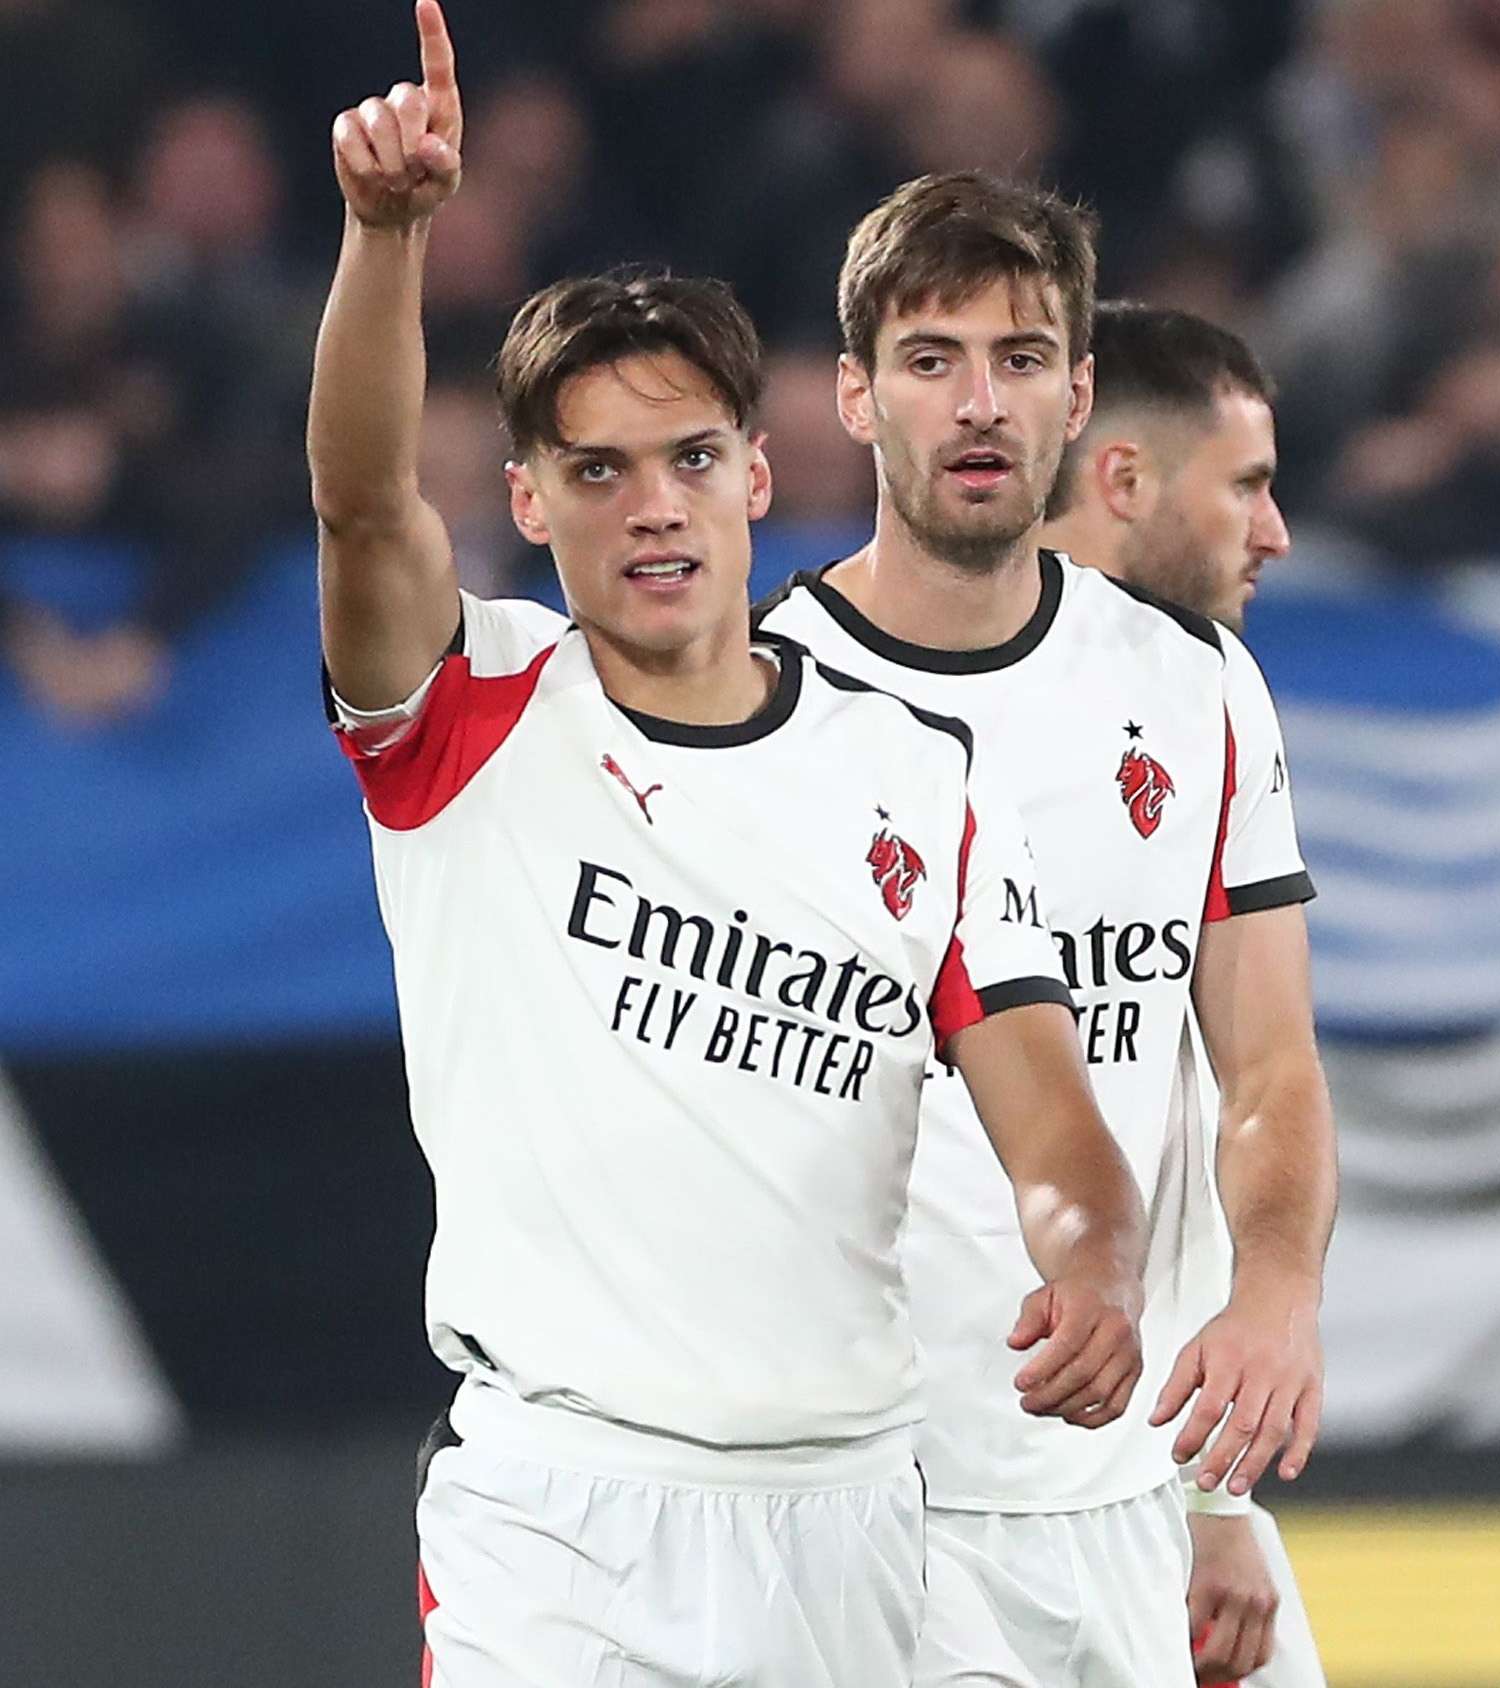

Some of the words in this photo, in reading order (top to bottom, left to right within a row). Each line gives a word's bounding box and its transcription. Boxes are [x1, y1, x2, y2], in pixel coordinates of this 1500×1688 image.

[567, 859, 922, 1038] Emirates
[611, 975, 698, 1050] FLY
[704, 1005, 874, 1101] BETTER
